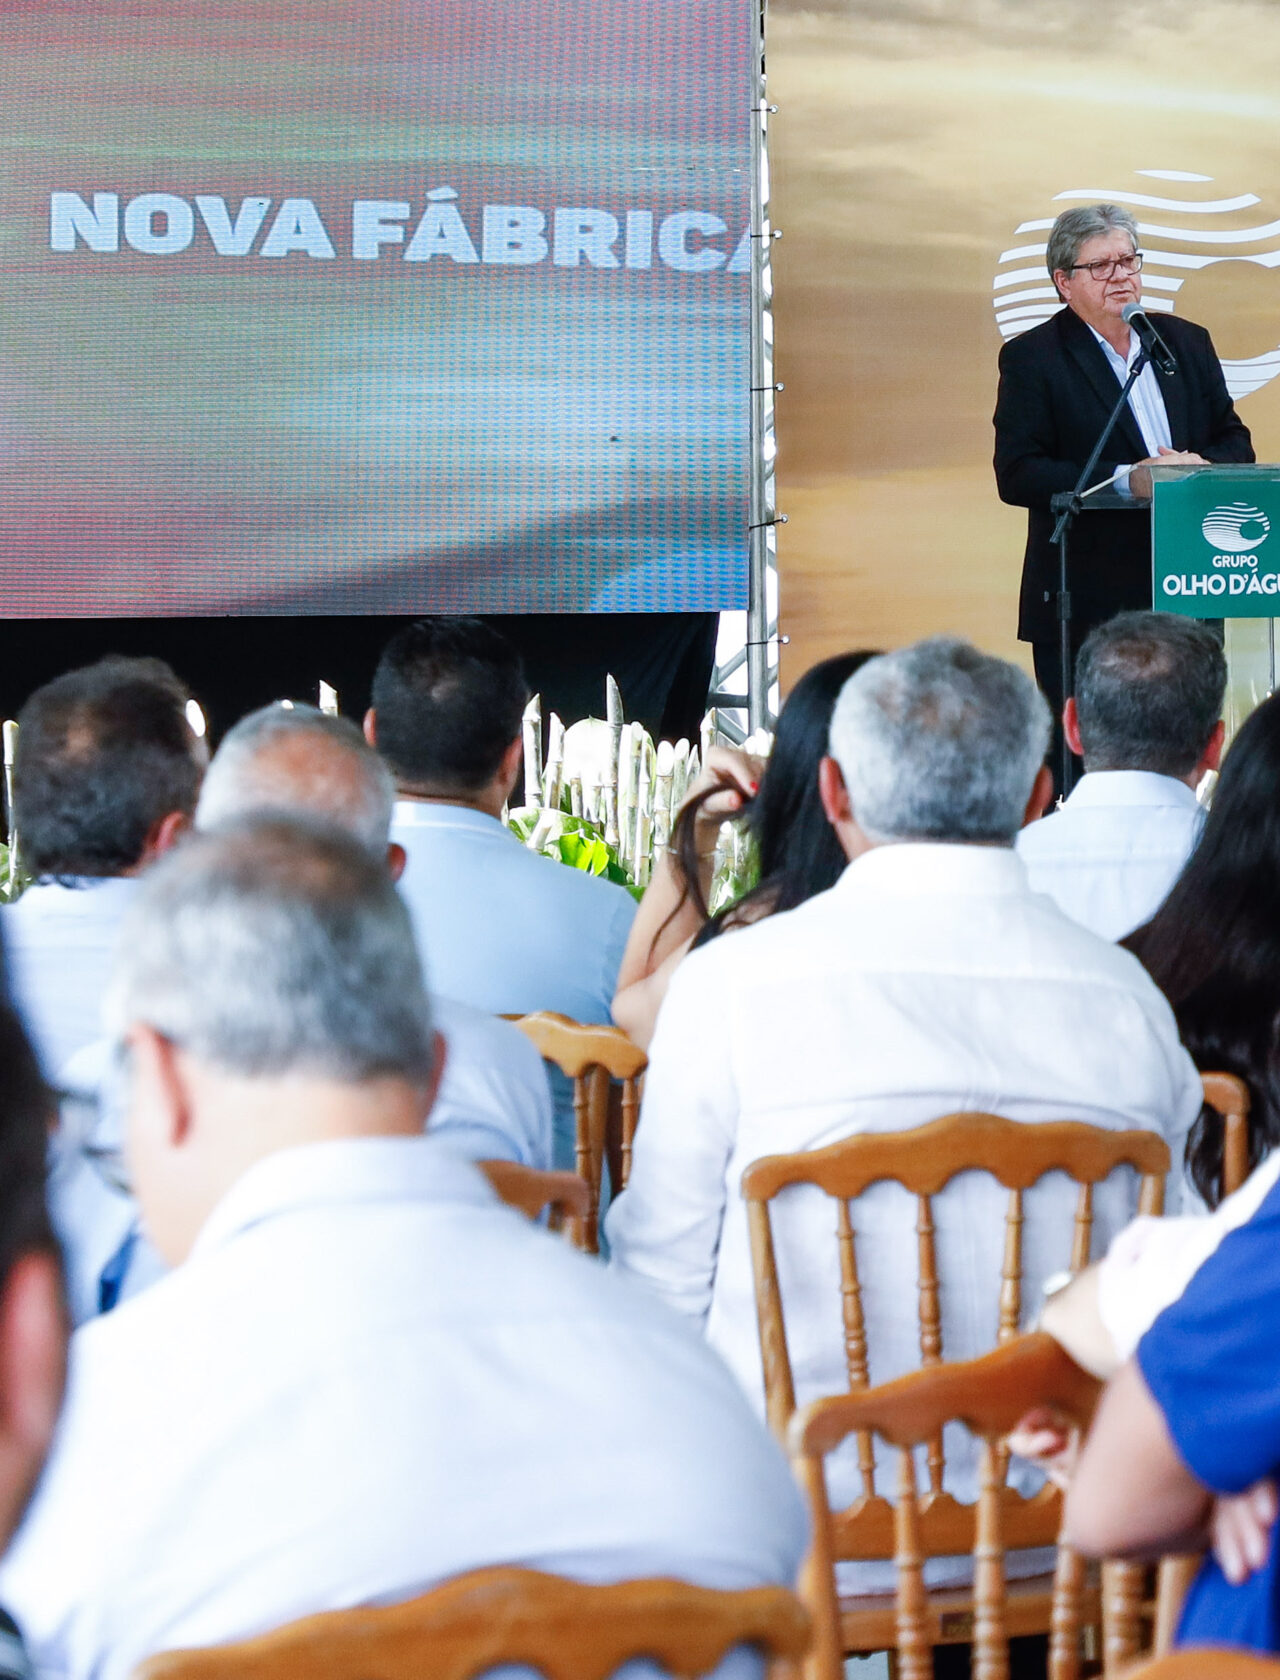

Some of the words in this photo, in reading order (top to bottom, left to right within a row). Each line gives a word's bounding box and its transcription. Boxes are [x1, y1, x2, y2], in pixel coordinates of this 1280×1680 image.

[50, 192, 336, 258] NOVA
[1212, 555, 1258, 568] GRUPO
[1162, 573, 1226, 596] OLHO
